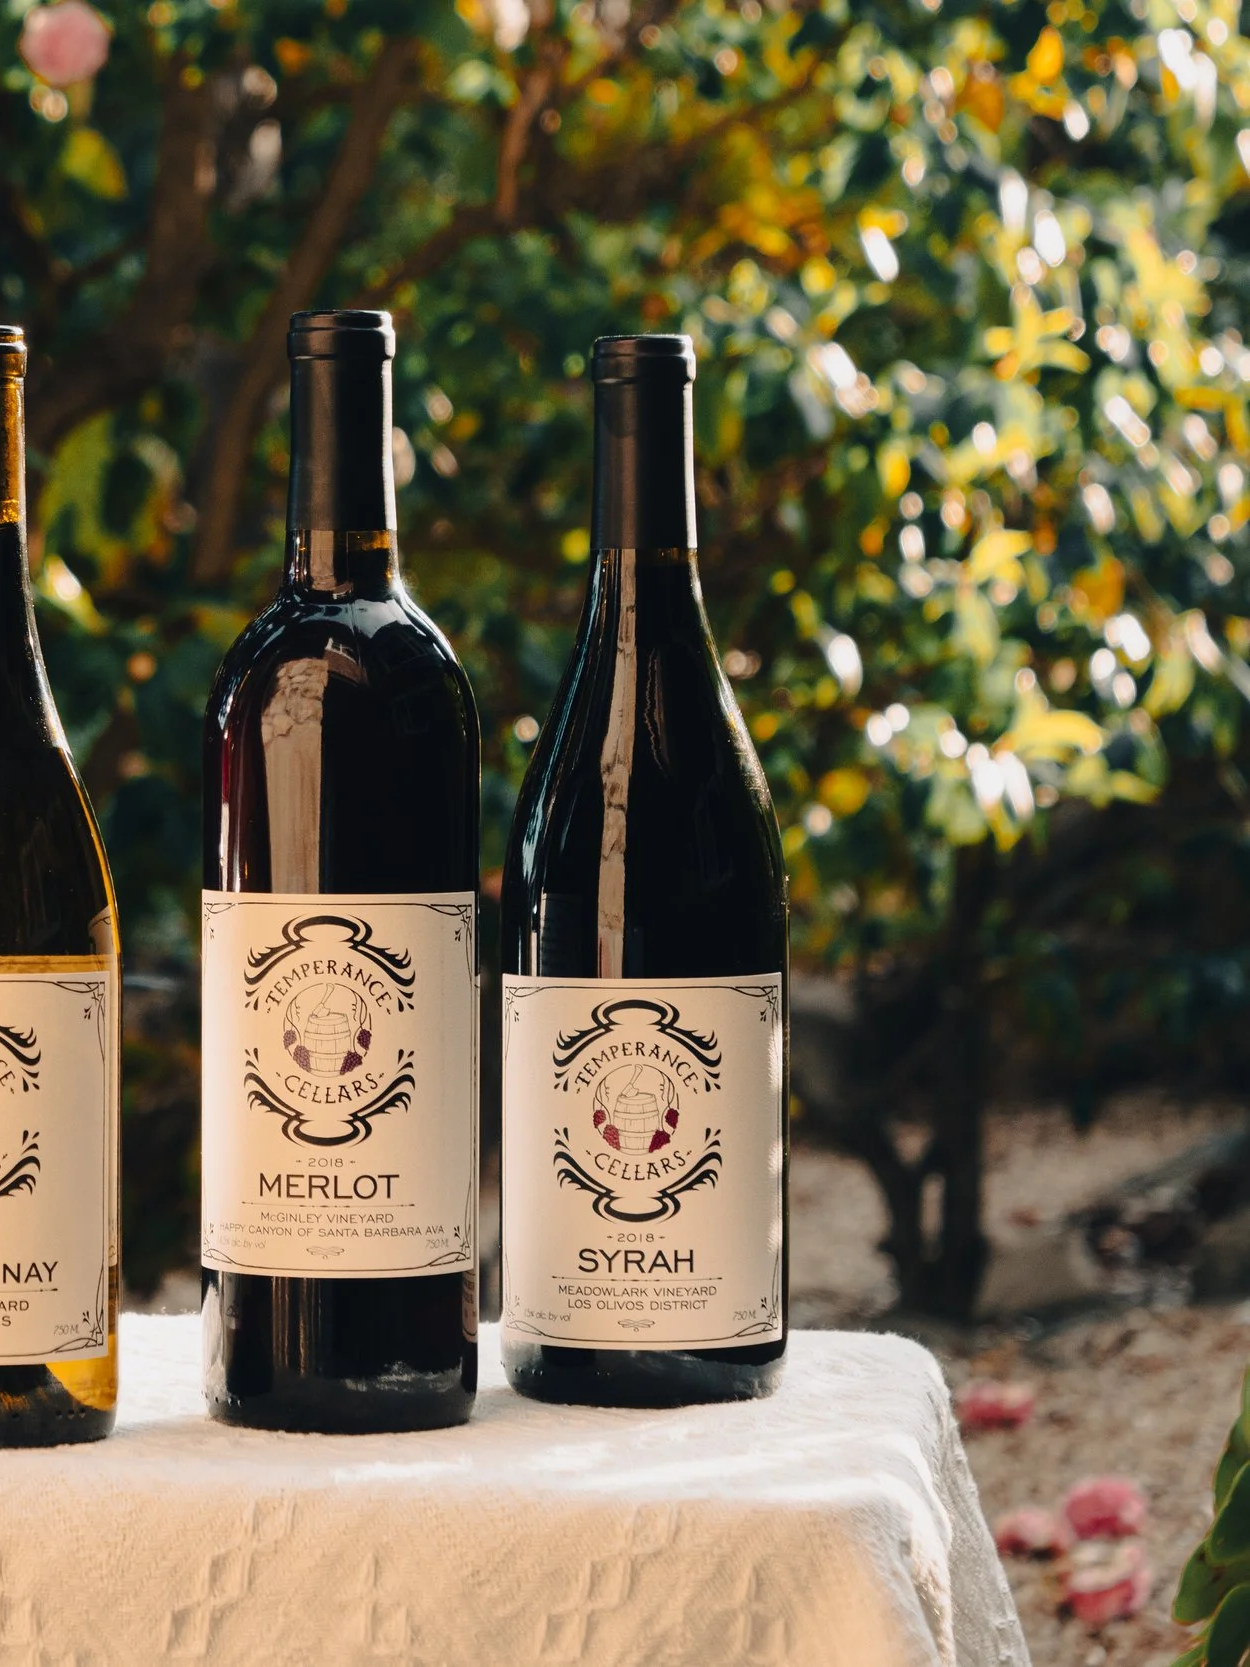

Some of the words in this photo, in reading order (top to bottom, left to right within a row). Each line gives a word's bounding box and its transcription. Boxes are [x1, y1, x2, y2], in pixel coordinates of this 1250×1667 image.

[265, 959, 392, 1008] TEMPERANCE
[574, 1041, 699, 1087] TEMPERANCE
[284, 1072, 379, 1104] CELLARS
[308, 1157, 344, 1168] 2018
[594, 1150, 686, 1181] CELLARS
[259, 1173, 400, 1200] MERLOT
[260, 1212, 323, 1223] McGINLEY
[326, 1213, 394, 1224] VINEYARD
[219, 1222, 246, 1233] HAPPY
[248, 1225, 292, 1237] CANYON
[297, 1227, 314, 1237] OF
[318, 1228, 359, 1238] SANTA
[364, 1227, 422, 1238] BARBARA
[425, 1225, 445, 1235] AVA
[425, 1239, 441, 1249] 750
[617, 1233, 655, 1243] 2018
[578, 1248, 694, 1274] SYRAH
[558, 1285, 649, 1297] MEADOWLARK
[653, 1286, 718, 1297] VINEYARD
[567, 1298, 591, 1310] LOS
[596, 1300, 644, 1310] OLIVOS
[650, 1299, 708, 1311] DISTRICT
[732, 1311, 748, 1321] 750
[53, 1325, 69, 1335] 750
